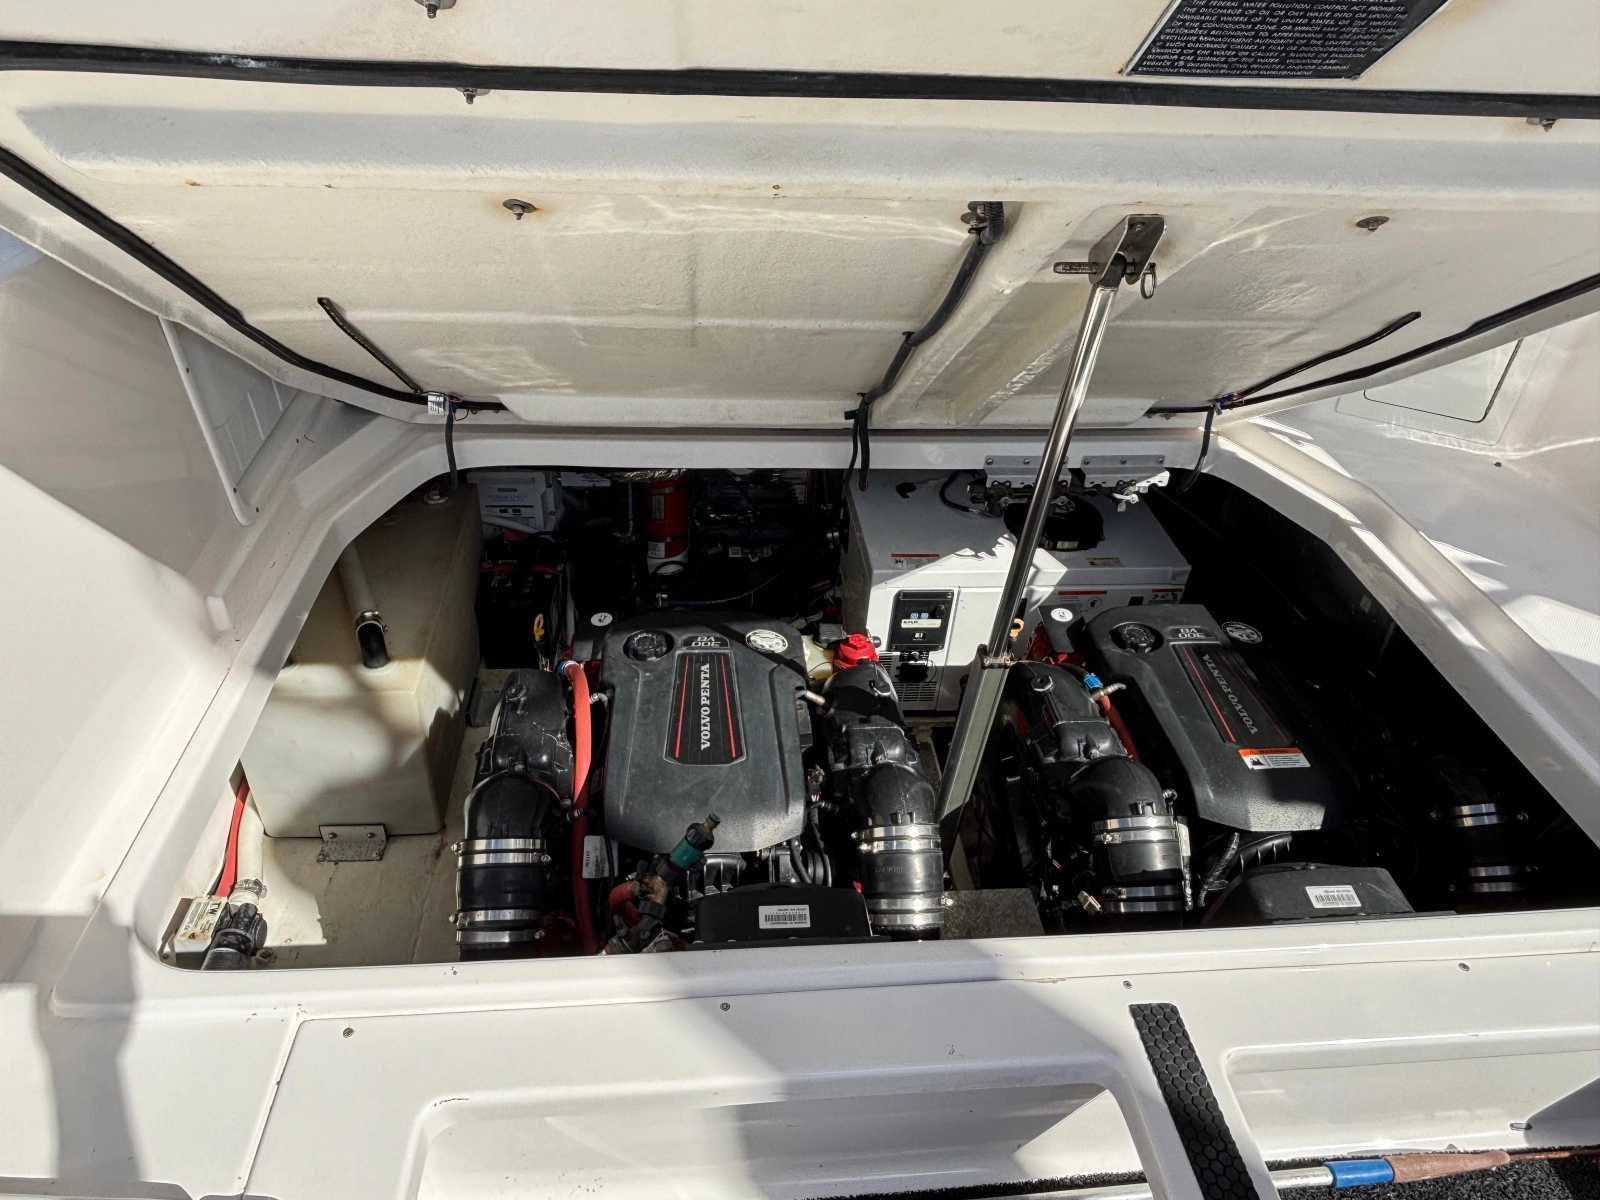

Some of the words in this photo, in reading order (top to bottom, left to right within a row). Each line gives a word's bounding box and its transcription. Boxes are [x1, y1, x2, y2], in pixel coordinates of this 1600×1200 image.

[700, 662, 710, 706] PENTA
[1202, 654, 1232, 694] PENTA
[700, 706, 711, 750] VOLVO
[1228, 694, 1258, 735] VOLVO
